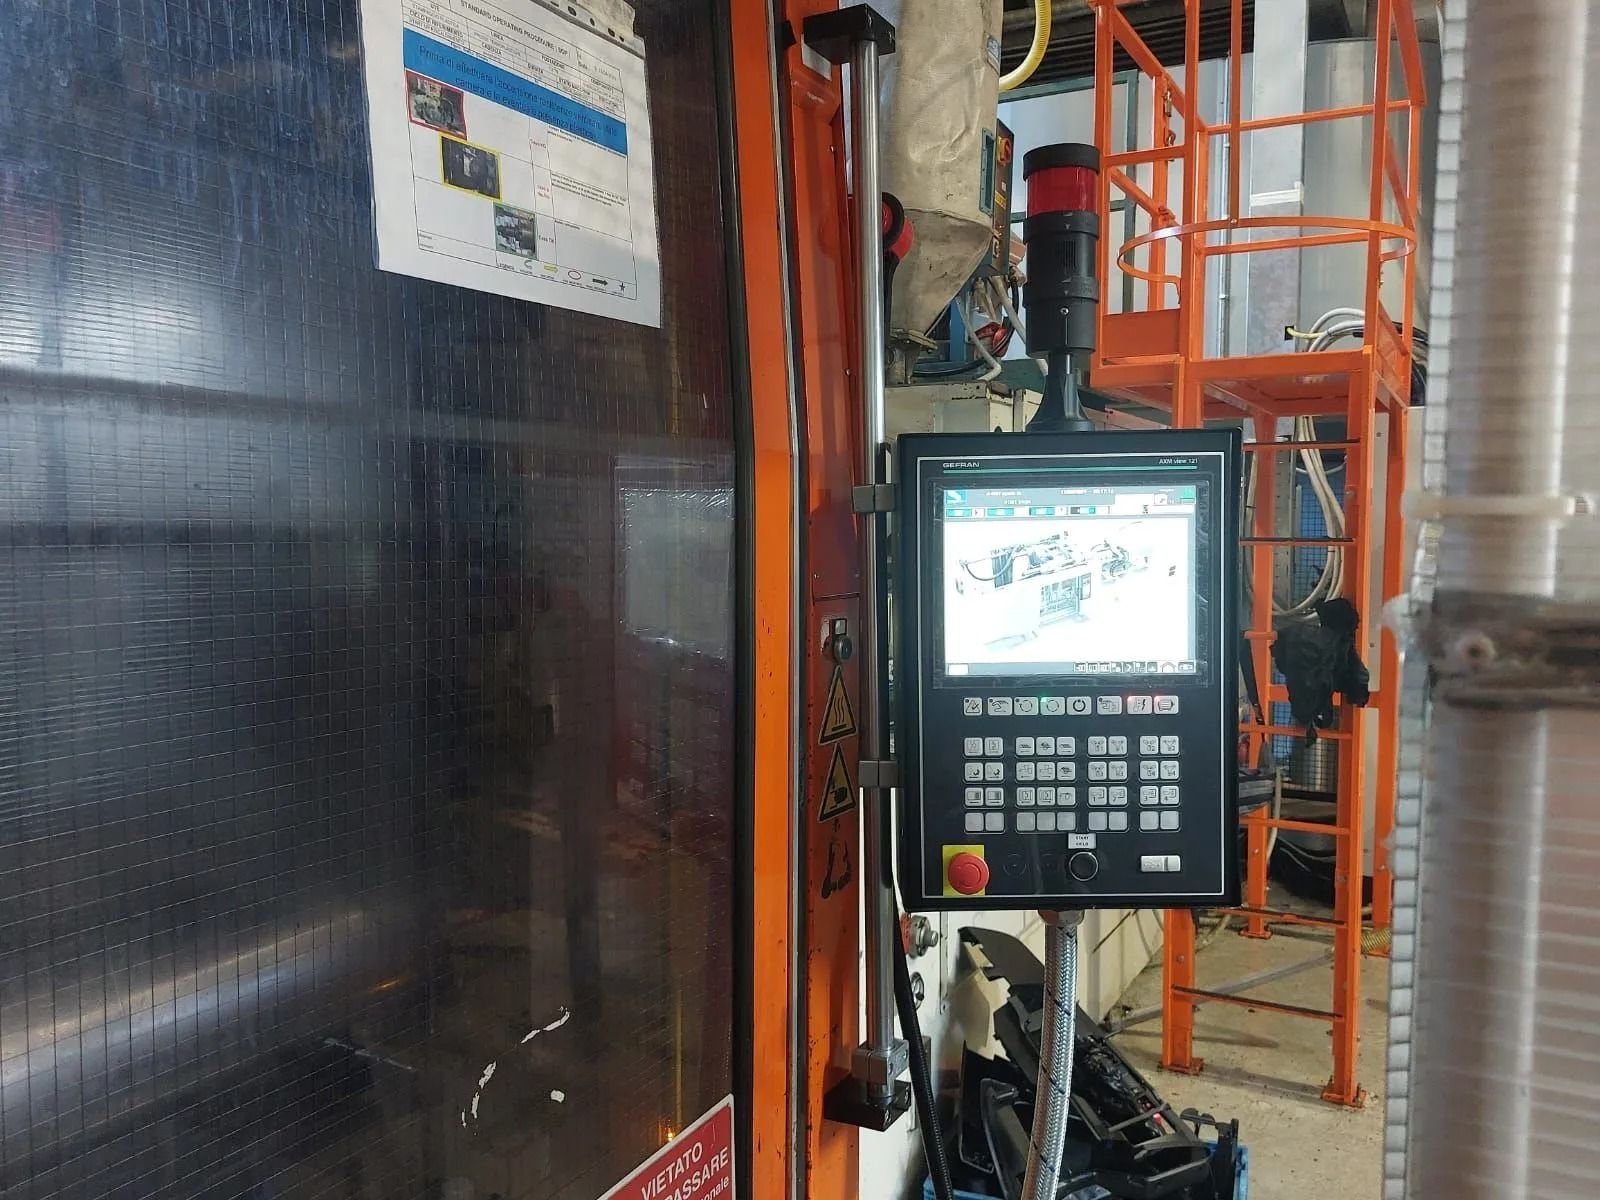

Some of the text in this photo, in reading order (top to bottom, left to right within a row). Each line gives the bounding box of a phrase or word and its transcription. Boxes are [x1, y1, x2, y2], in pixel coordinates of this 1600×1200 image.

[461, 1, 491, 20] STANDARD
[492, 15, 523, 35] OPERATING
[419, 44, 444, 64] Prima
[641, 1141, 702, 1200] VIETATO
